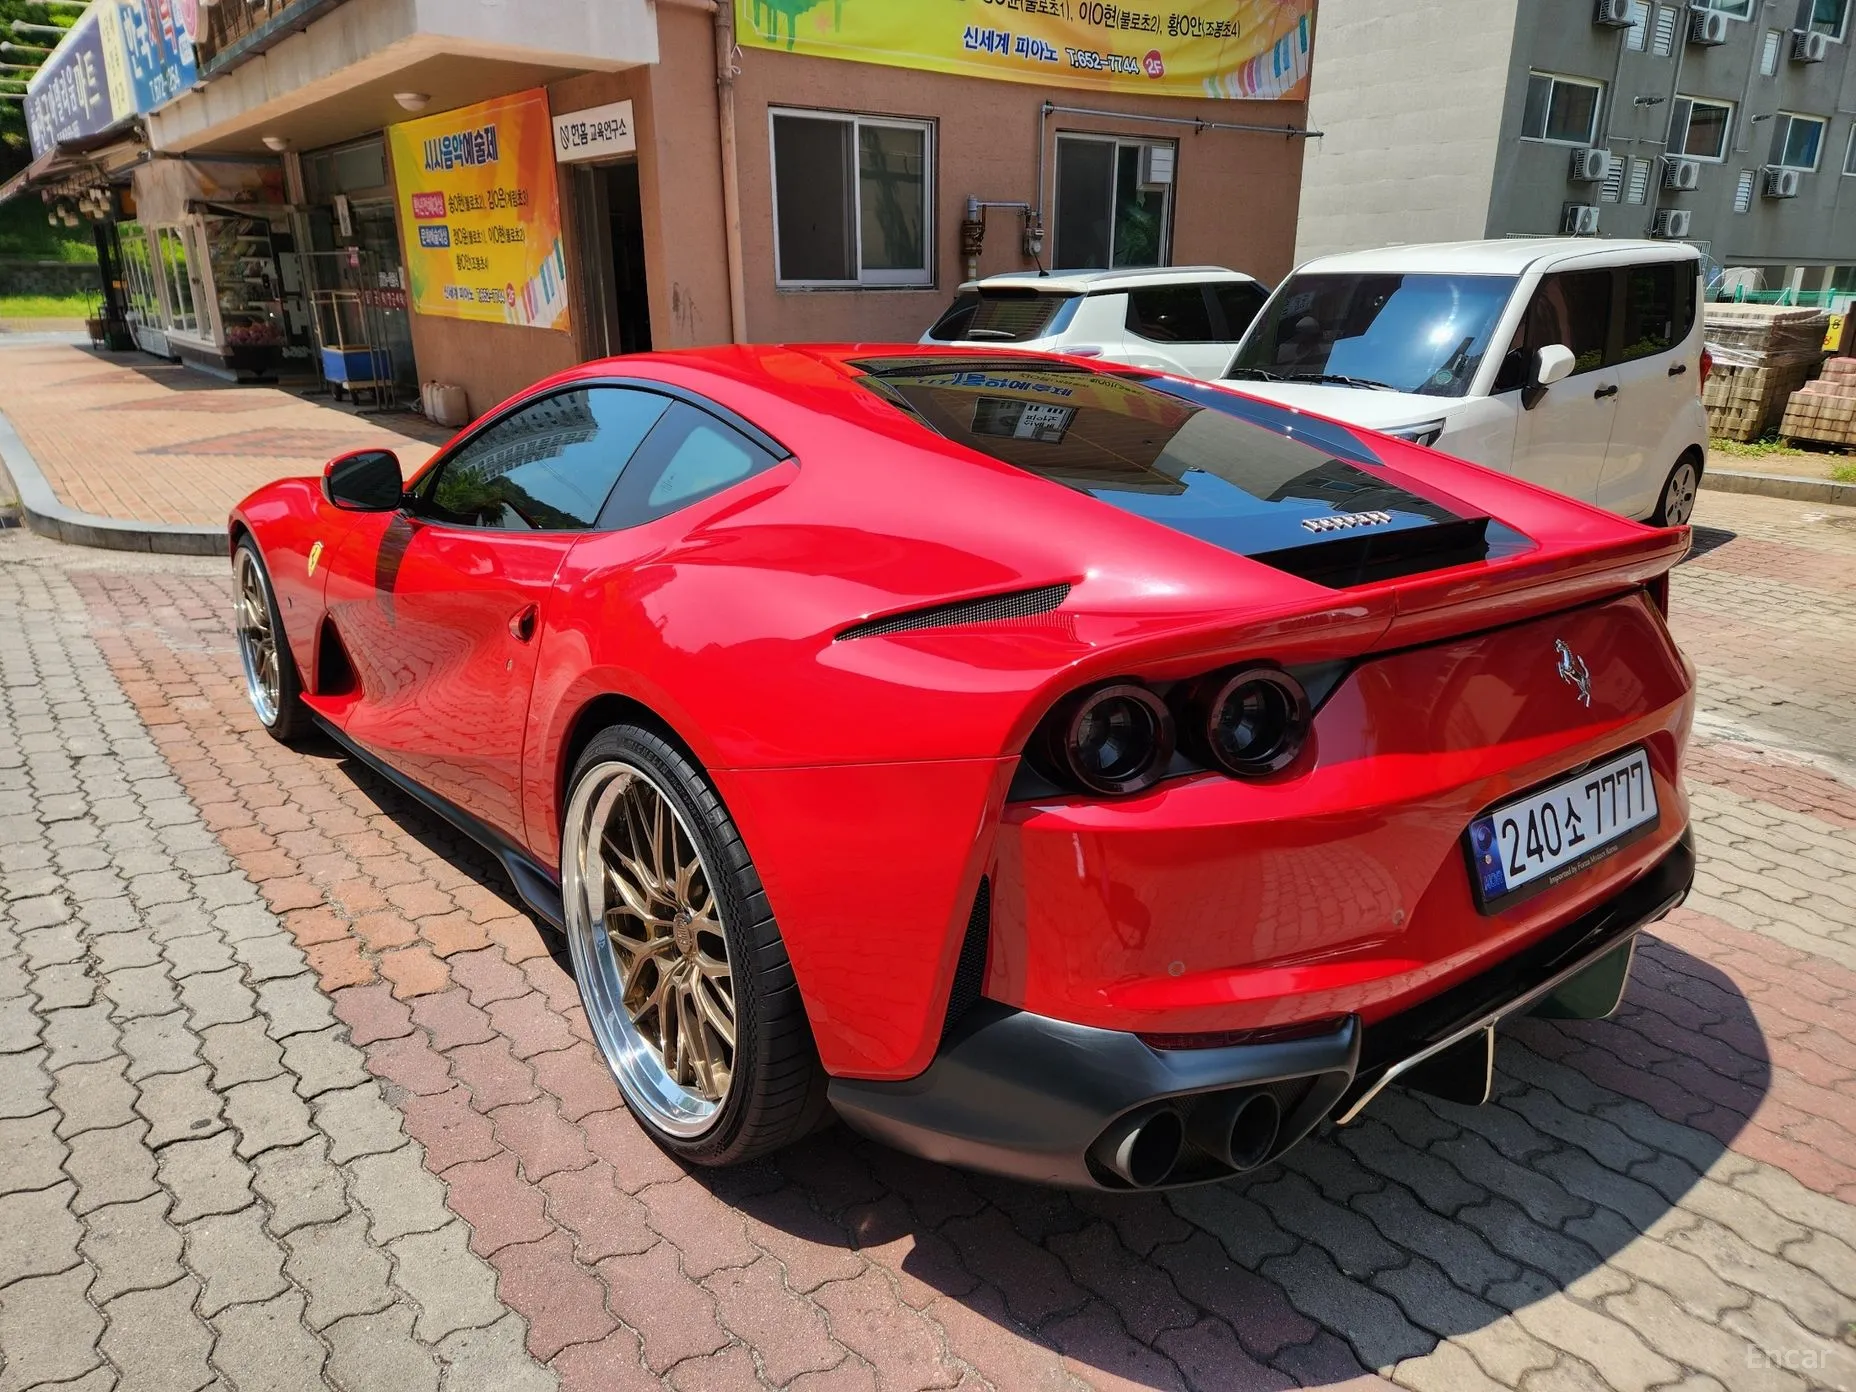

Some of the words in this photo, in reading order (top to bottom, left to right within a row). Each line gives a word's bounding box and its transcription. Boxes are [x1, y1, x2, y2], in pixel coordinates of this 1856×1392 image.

[964, 26, 1009, 54] 신세계
[1015, 36, 1058, 62] 피아노
[1066, 48, 1140, 75] T.652-7744
[1147, 58, 1162, 75] 2F
[423, 126, 498, 171] 시사음악예술제
[590, 118, 627, 142] 교육연구소
[1502, 797, 1585, 877] 240소
[1585, 760, 1645, 835] 7777
